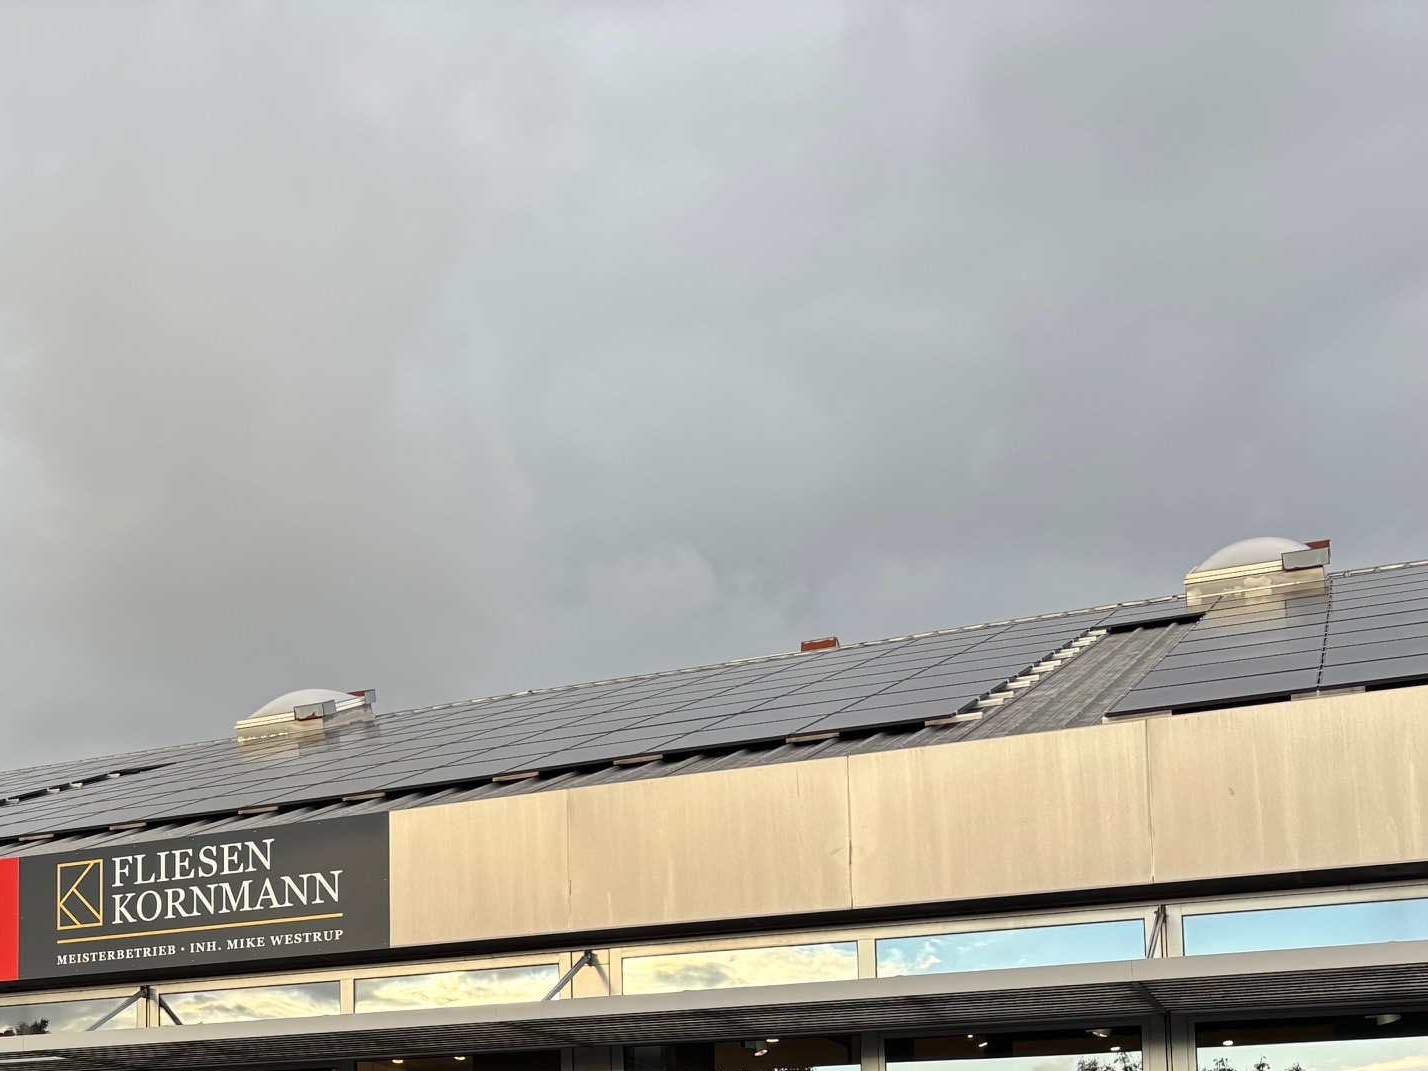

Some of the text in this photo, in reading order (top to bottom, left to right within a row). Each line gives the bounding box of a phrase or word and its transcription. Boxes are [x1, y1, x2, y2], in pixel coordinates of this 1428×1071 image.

[111, 838, 275, 888] FLIESEN
[111, 869, 343, 925] KORNMANN
[56, 929, 344, 966] MEISTERBETRIEB INH. MIKE WESTRUP
